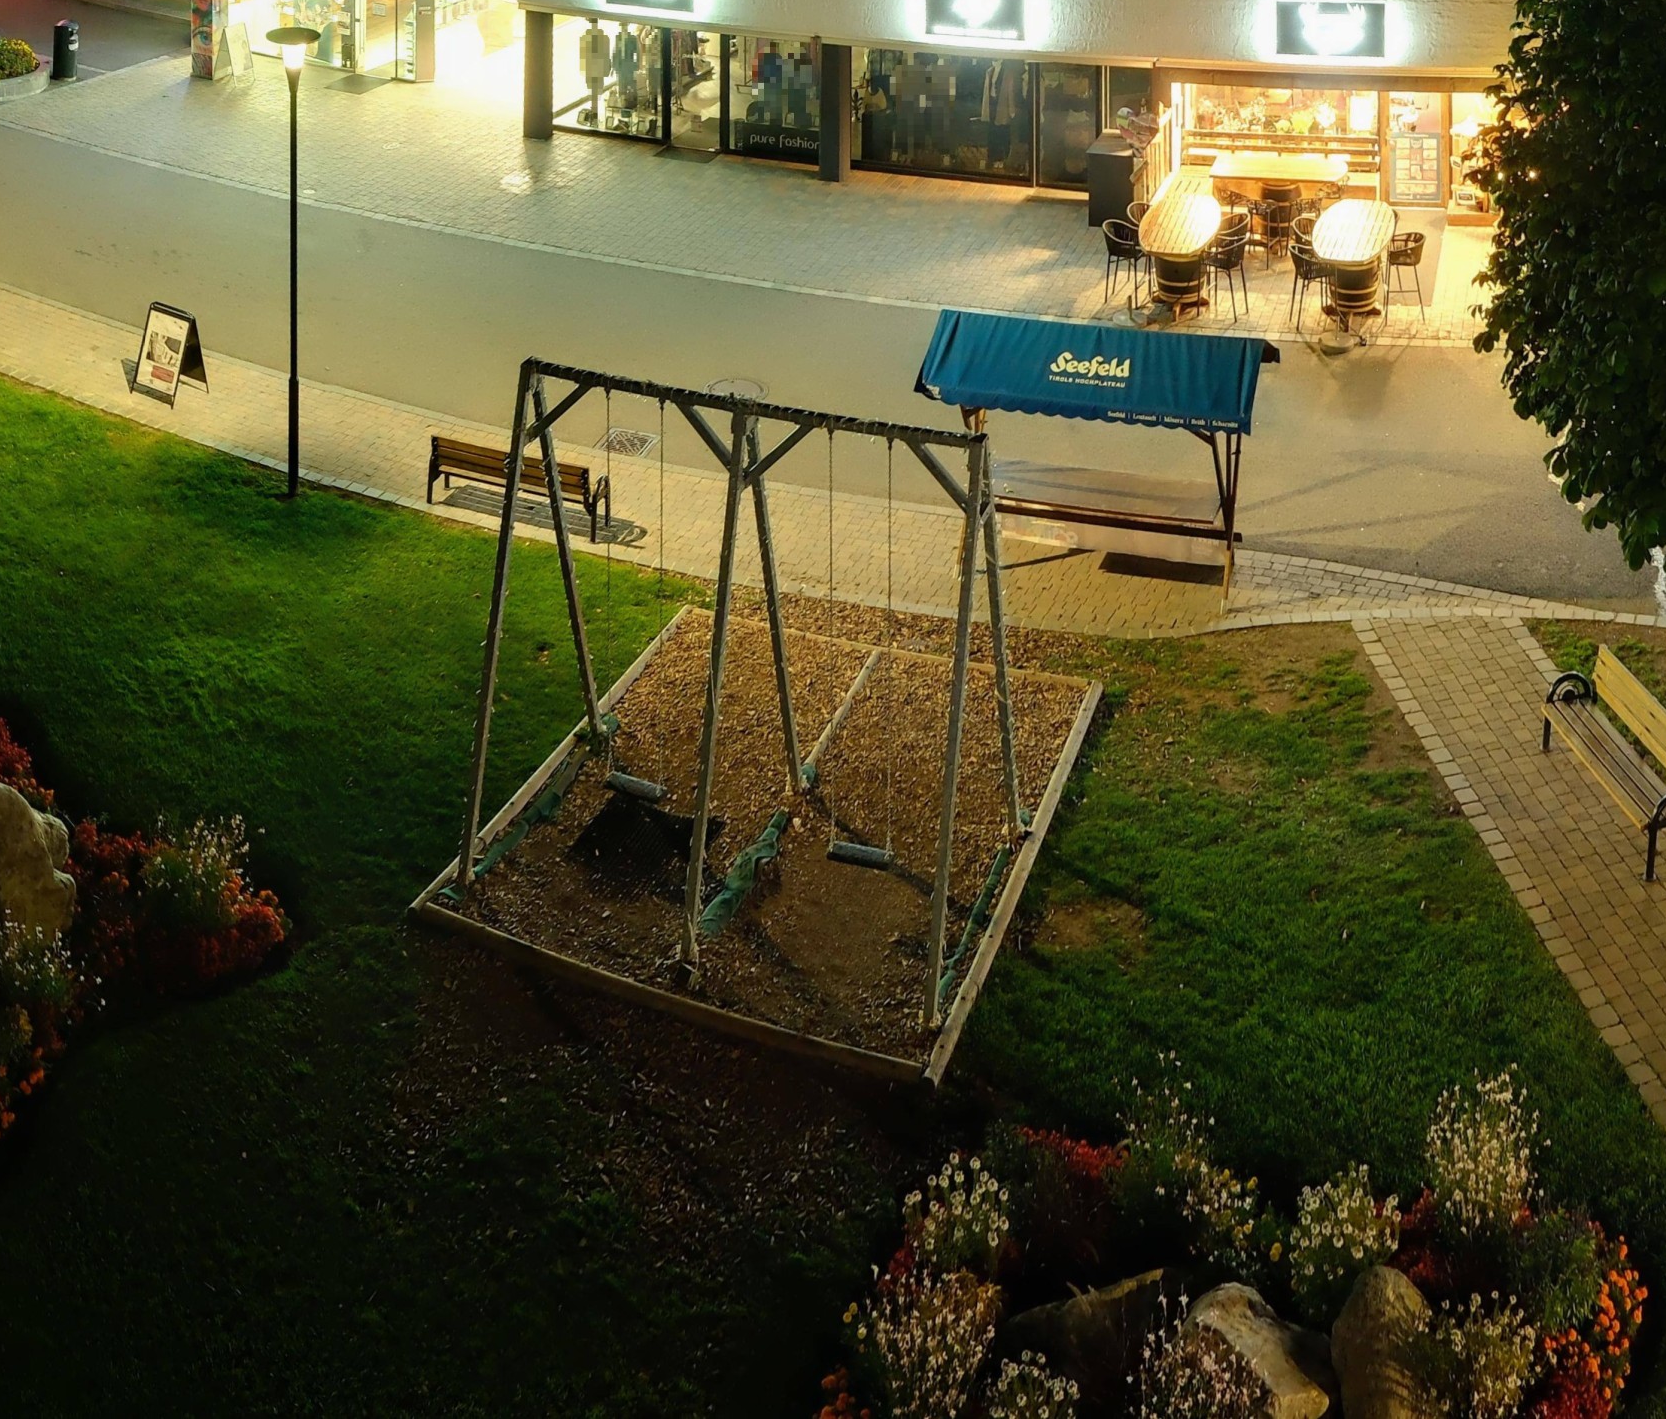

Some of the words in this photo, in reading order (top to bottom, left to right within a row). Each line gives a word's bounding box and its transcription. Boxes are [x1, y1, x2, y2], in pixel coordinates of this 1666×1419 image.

[749, 134, 776, 145] pure
[1050, 350, 1131, 379] Seefeld
[1048, 375, 1073, 383] TIROLS
[1075, 377, 1126, 388] HOCHPLATEAU
